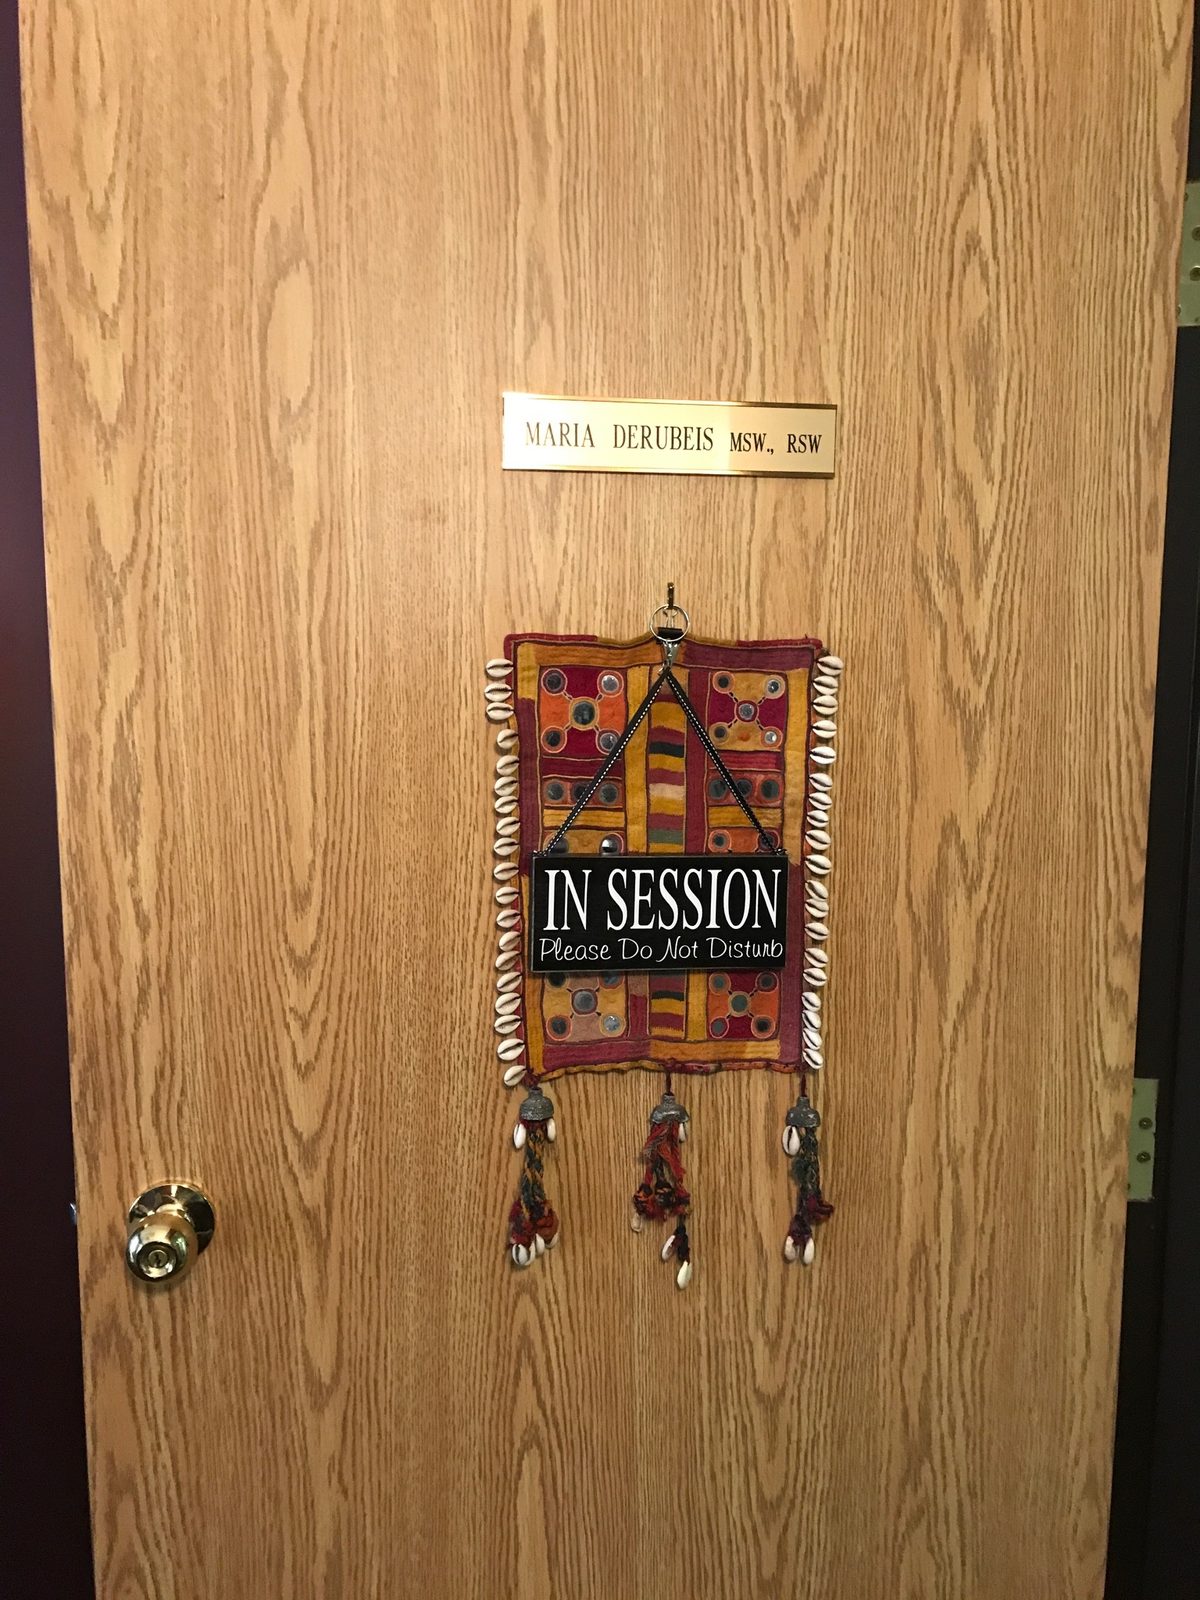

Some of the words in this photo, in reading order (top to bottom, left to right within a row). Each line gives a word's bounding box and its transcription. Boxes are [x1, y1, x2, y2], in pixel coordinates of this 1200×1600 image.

[525, 421, 596, 448] MARIA
[613, 424, 714, 451] DERUBEIS
[786, 433, 823, 454] RSW
[543, 869, 592, 931] IN
[606, 868, 782, 931] SESSION
[539, 937, 611, 961] Please
[617, 937, 653, 960] Do
[656, 935, 699, 963] Not
[706, 937, 783, 959] Disturb
